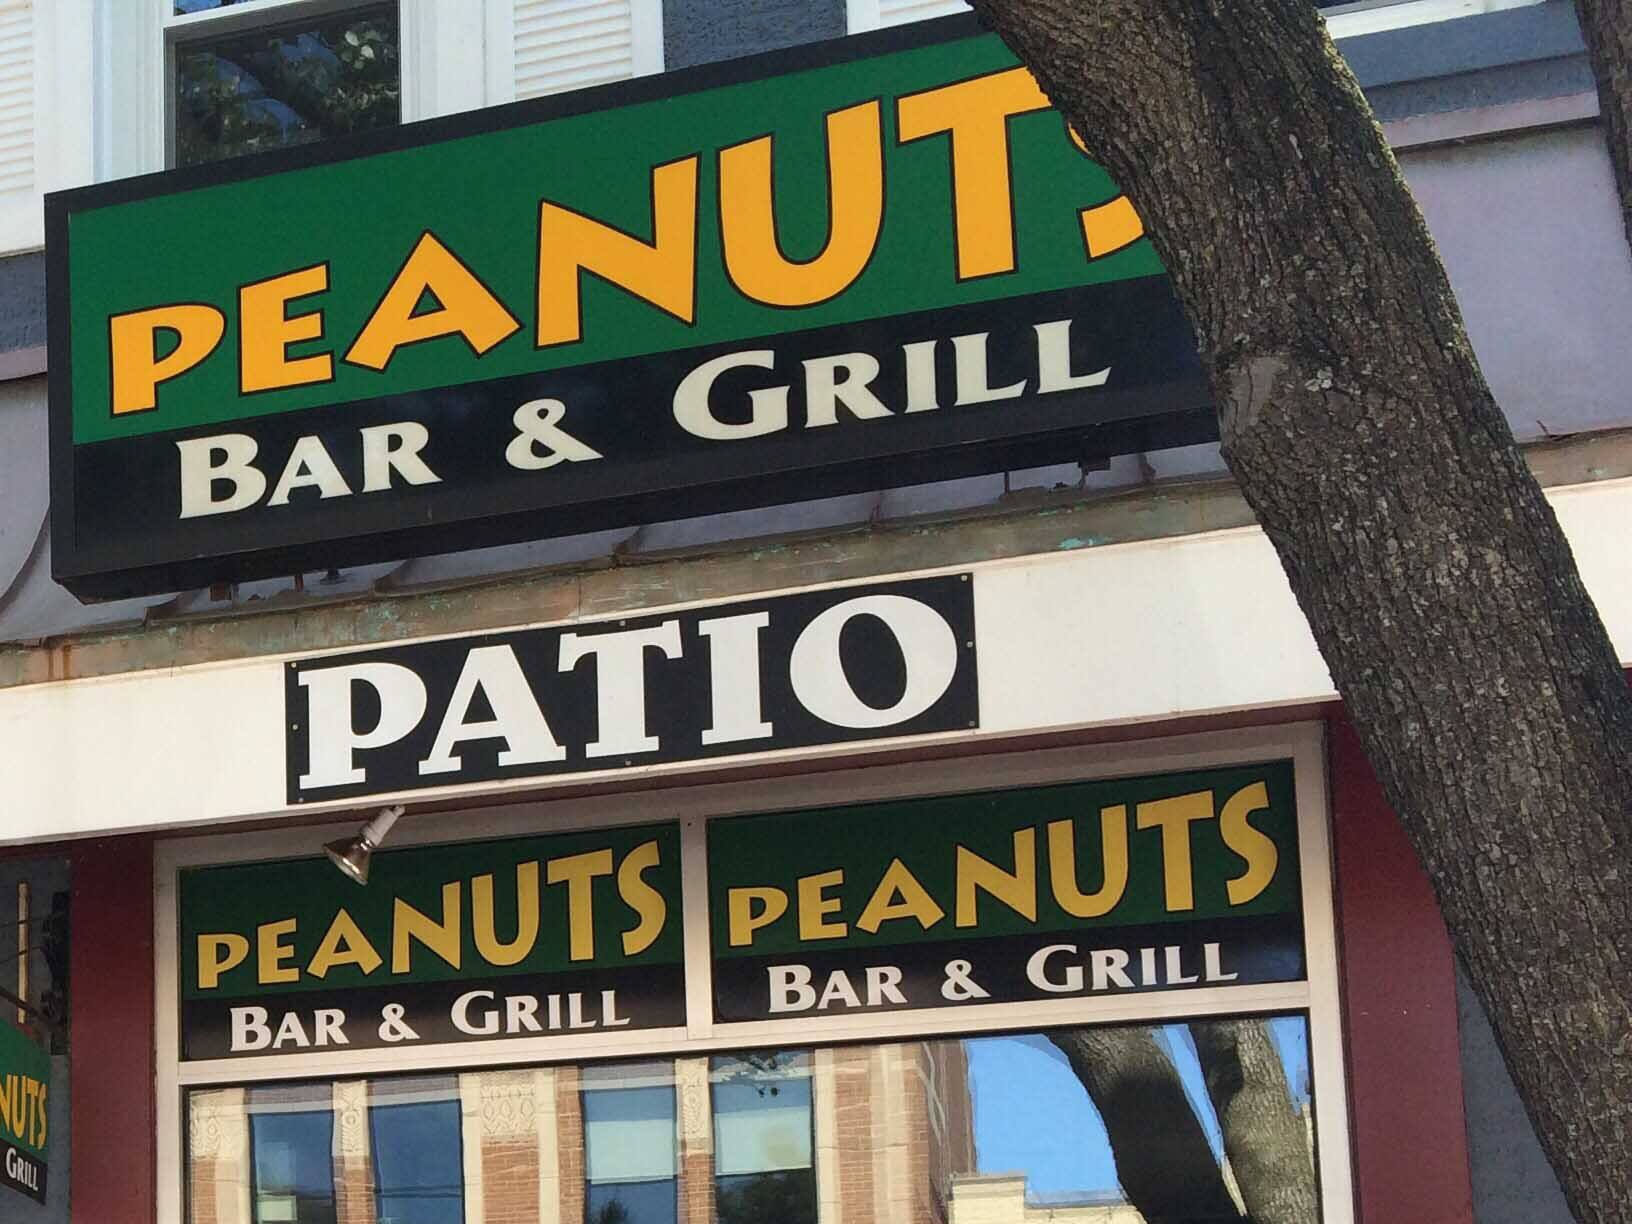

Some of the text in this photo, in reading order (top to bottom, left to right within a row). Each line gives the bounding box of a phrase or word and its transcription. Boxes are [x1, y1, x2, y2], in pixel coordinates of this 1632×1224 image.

[109, 65, 1145, 415] PEANUT
[179, 318, 1111, 519] BAR & GRILL
[296, 592, 959, 790] PATIO
[196, 840, 668, 990] PEANUTS
[727, 780, 1279, 947] PEANUTS
[229, 989, 631, 1053] BAR & GRILL
[767, 942, 1239, 1013] BAR & GRILL
[5, 1146, 39, 1191] GRILL
